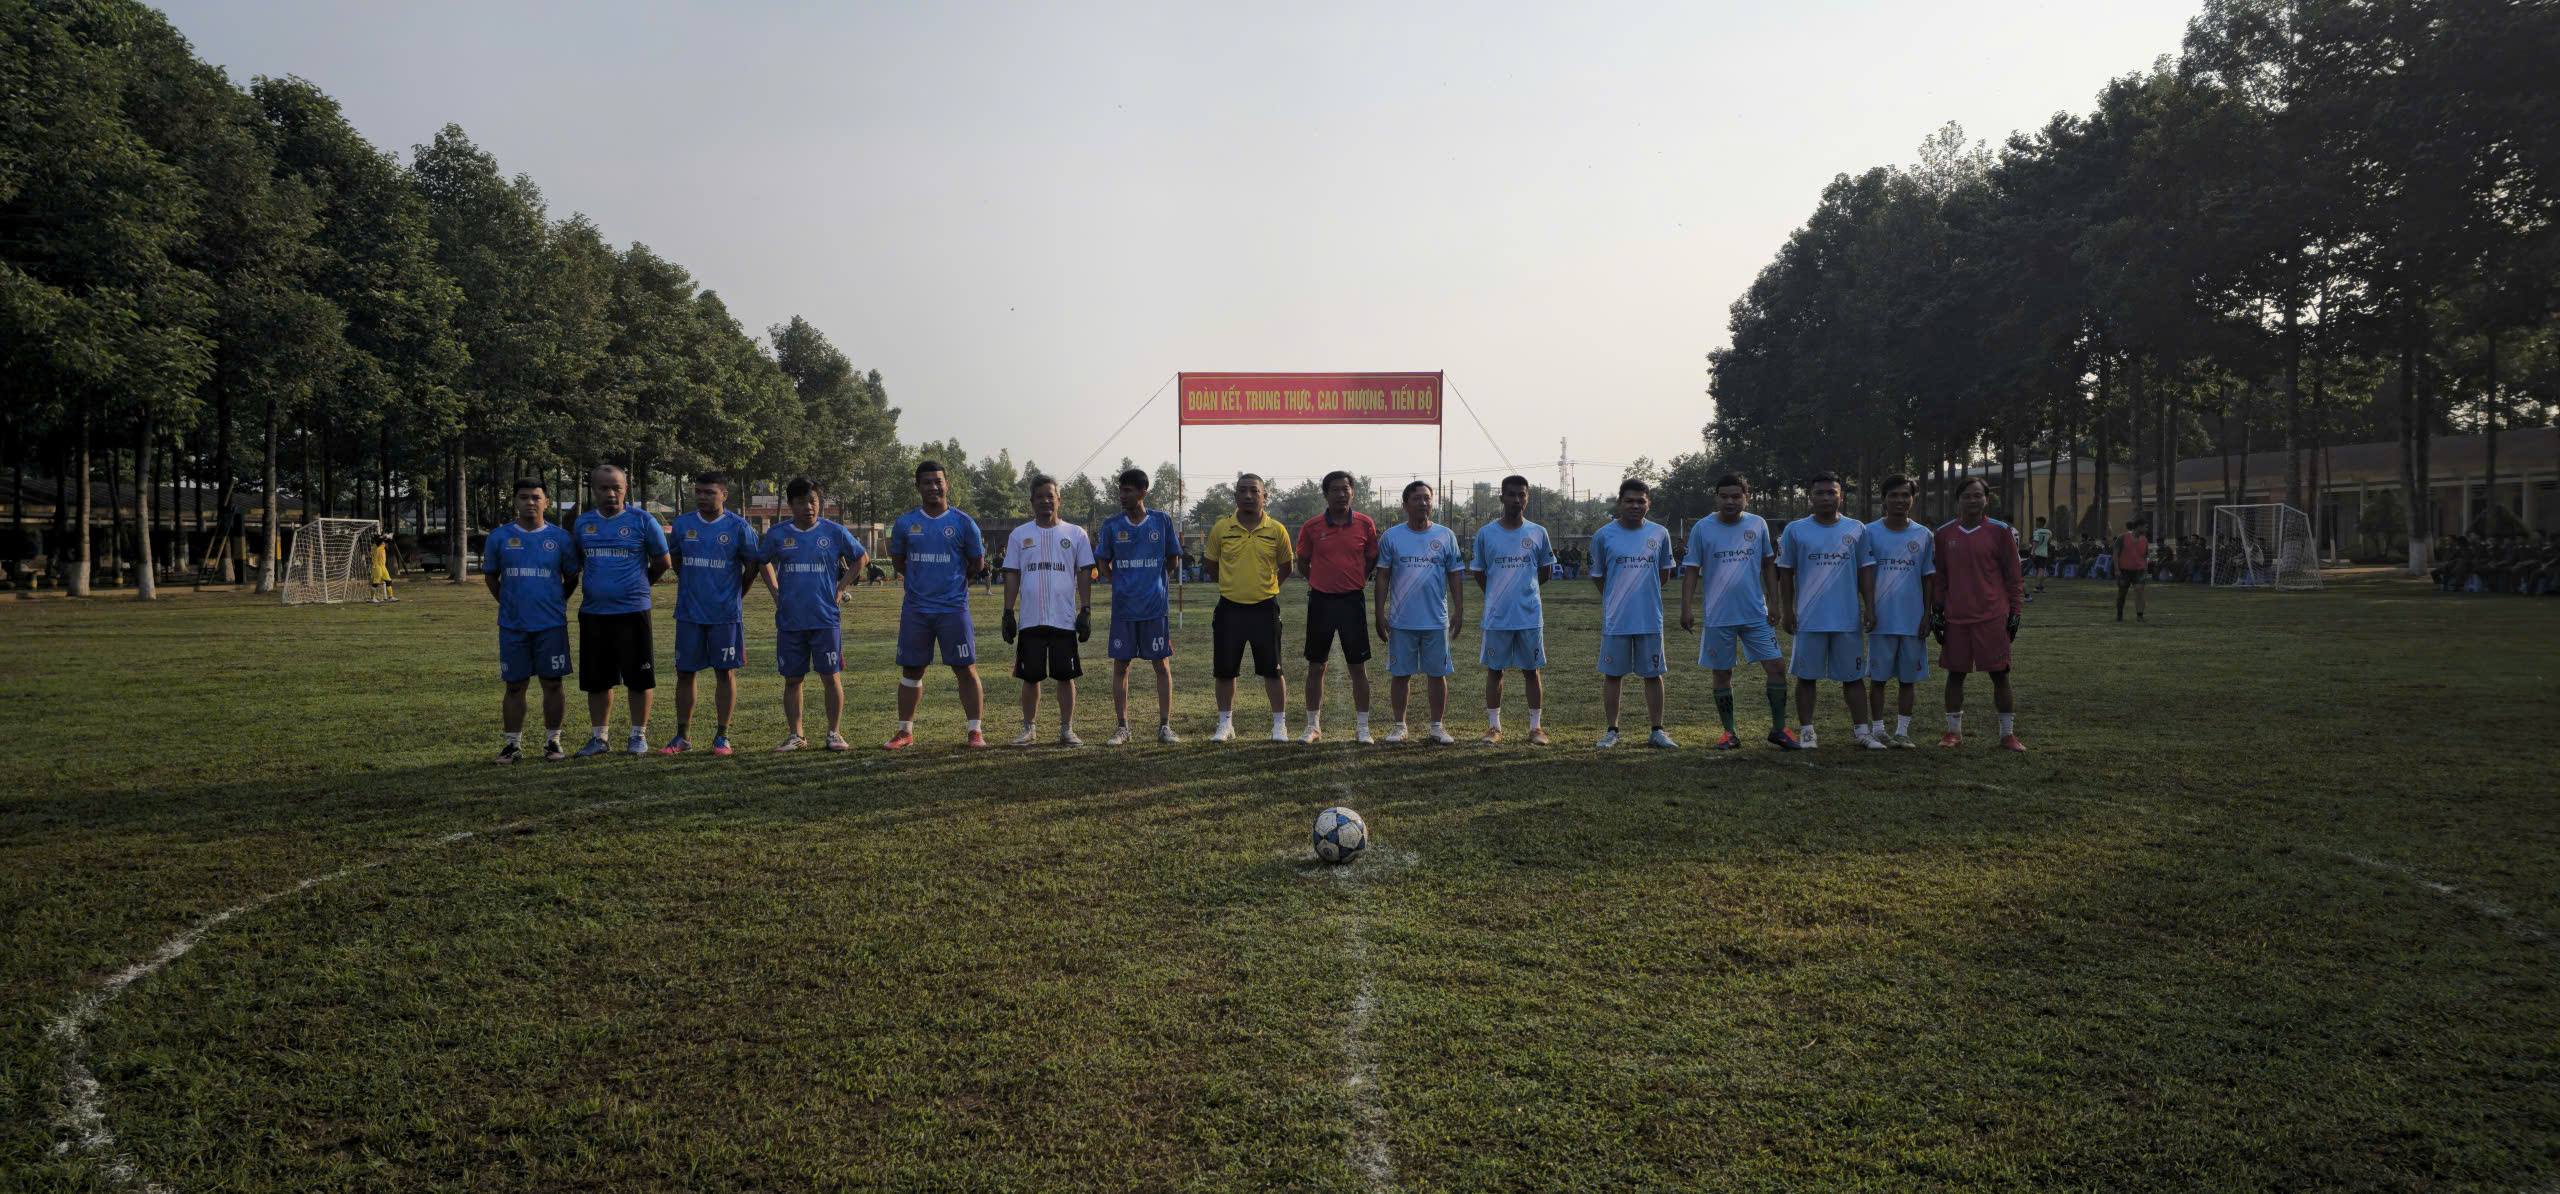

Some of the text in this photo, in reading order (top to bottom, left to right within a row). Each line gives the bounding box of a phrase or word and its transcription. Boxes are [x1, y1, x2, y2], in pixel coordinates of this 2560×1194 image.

[1188, 384, 1432, 415] ĐOÀN KẾT, TRUNG THỰC, CAO THƯỢNG, TIẾN BỘ
[1400, 556, 1441, 564] ETIHAD
[1495, 555, 1532, 564] ETIHAD
[1615, 556, 1655, 564] ETIHAD
[1713, 548, 1754, 558] ETIHAD
[1877, 558, 1915, 566] ETIHAD
[956, 643, 970, 658] 10
[1152, 637, 1164, 651] 69
[721, 646, 736, 662] 79
[825, 651, 837, 666] 19
[551, 654, 565, 670] 59
[1855, 656, 1862, 672] 8
